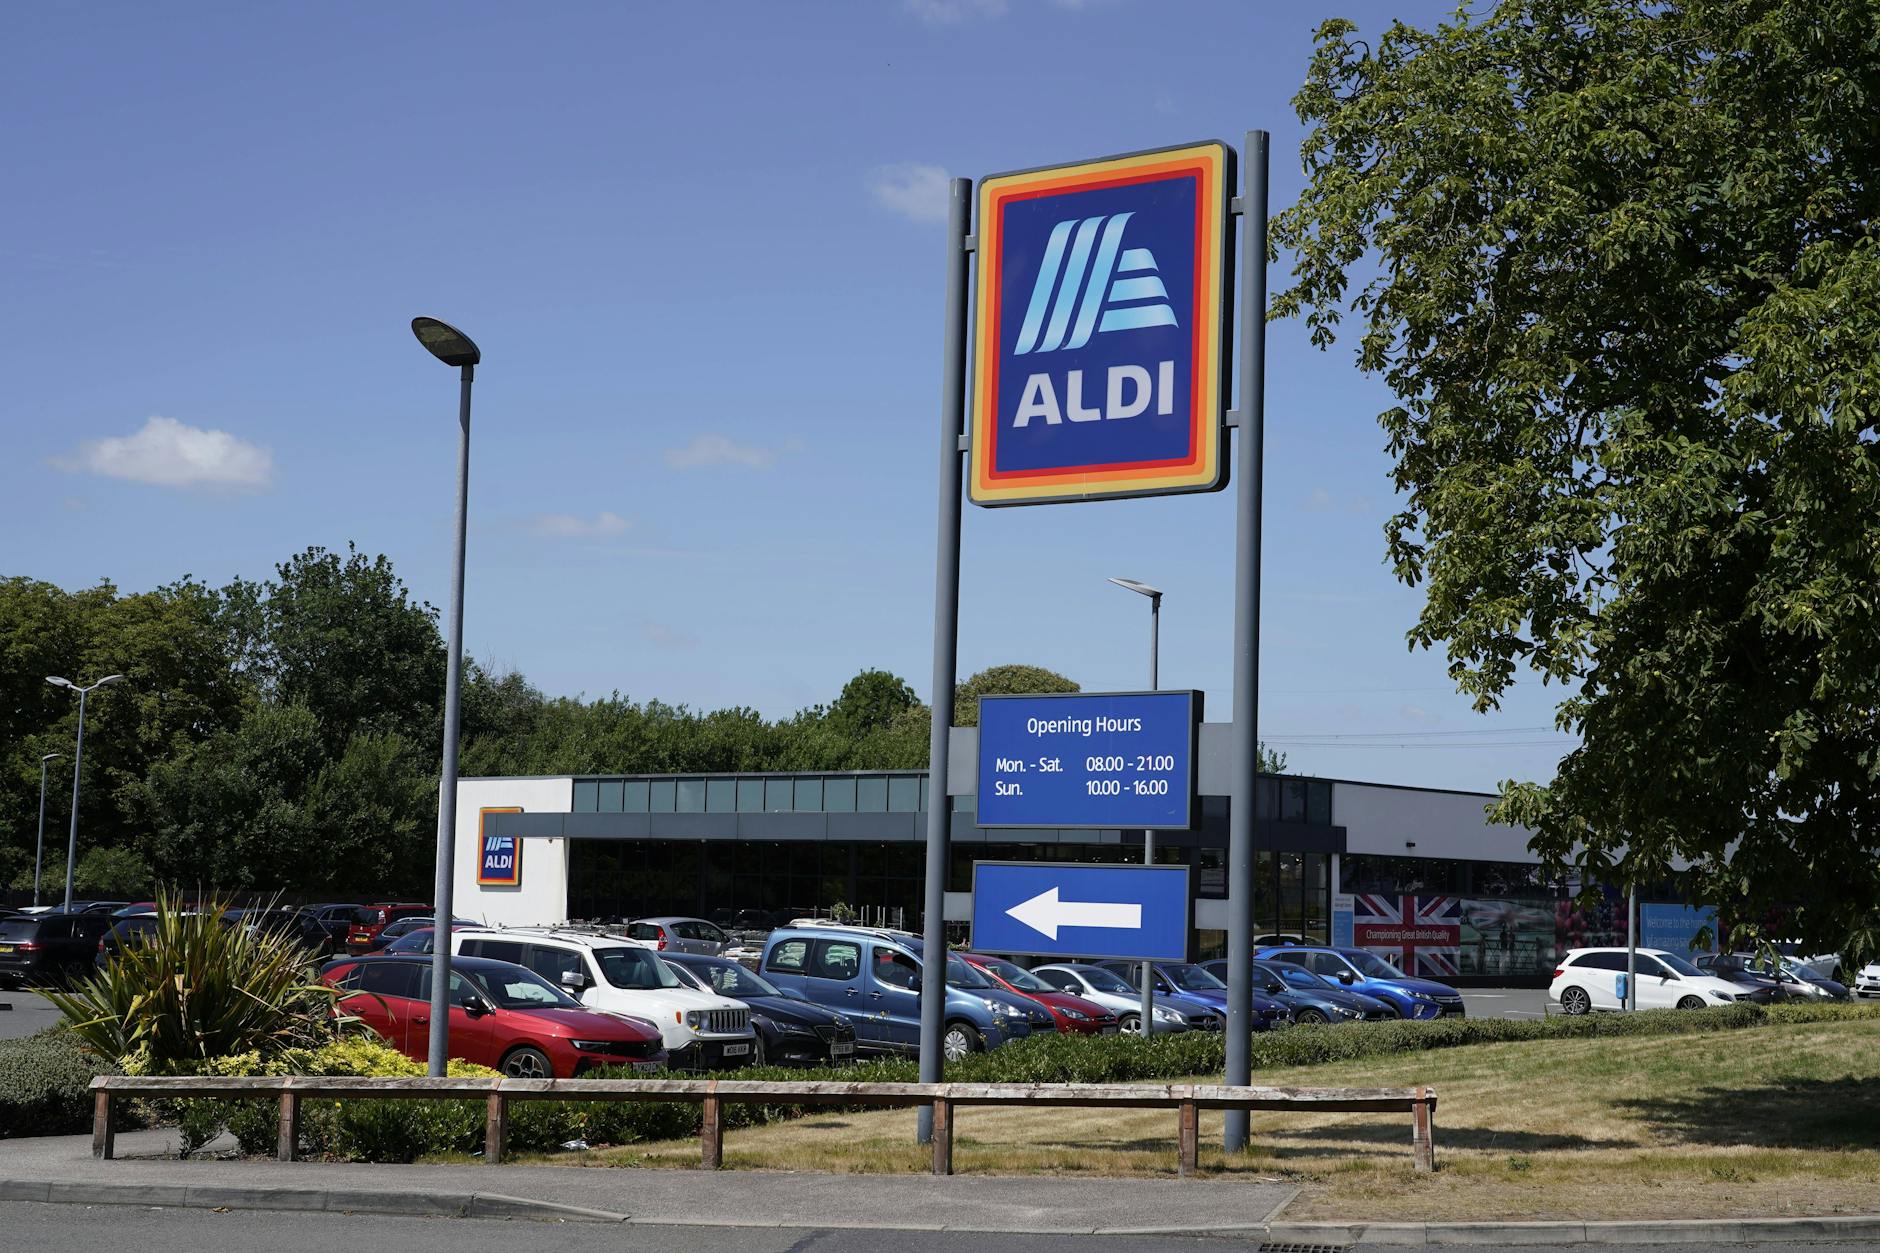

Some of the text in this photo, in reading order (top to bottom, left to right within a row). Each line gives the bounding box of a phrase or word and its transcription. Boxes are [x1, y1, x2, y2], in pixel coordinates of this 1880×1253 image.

[1013, 360, 1174, 428] ALDI
[1027, 716, 1142, 737] Opening Hours
[995, 758, 1026, 772] Mon.
[1039, 757, 1063, 772] Sat.
[1086, 756, 1124, 772] 08.00
[1136, 755, 1174, 771] 21.00
[995, 781, 1023, 796] Sun.
[1086, 780, 1120, 795] 10.00
[1133, 780, 1168, 795] 16.00
[485, 855, 512, 868] ALDI
[1366, 929, 1450, 942] Championing Great British Quality
